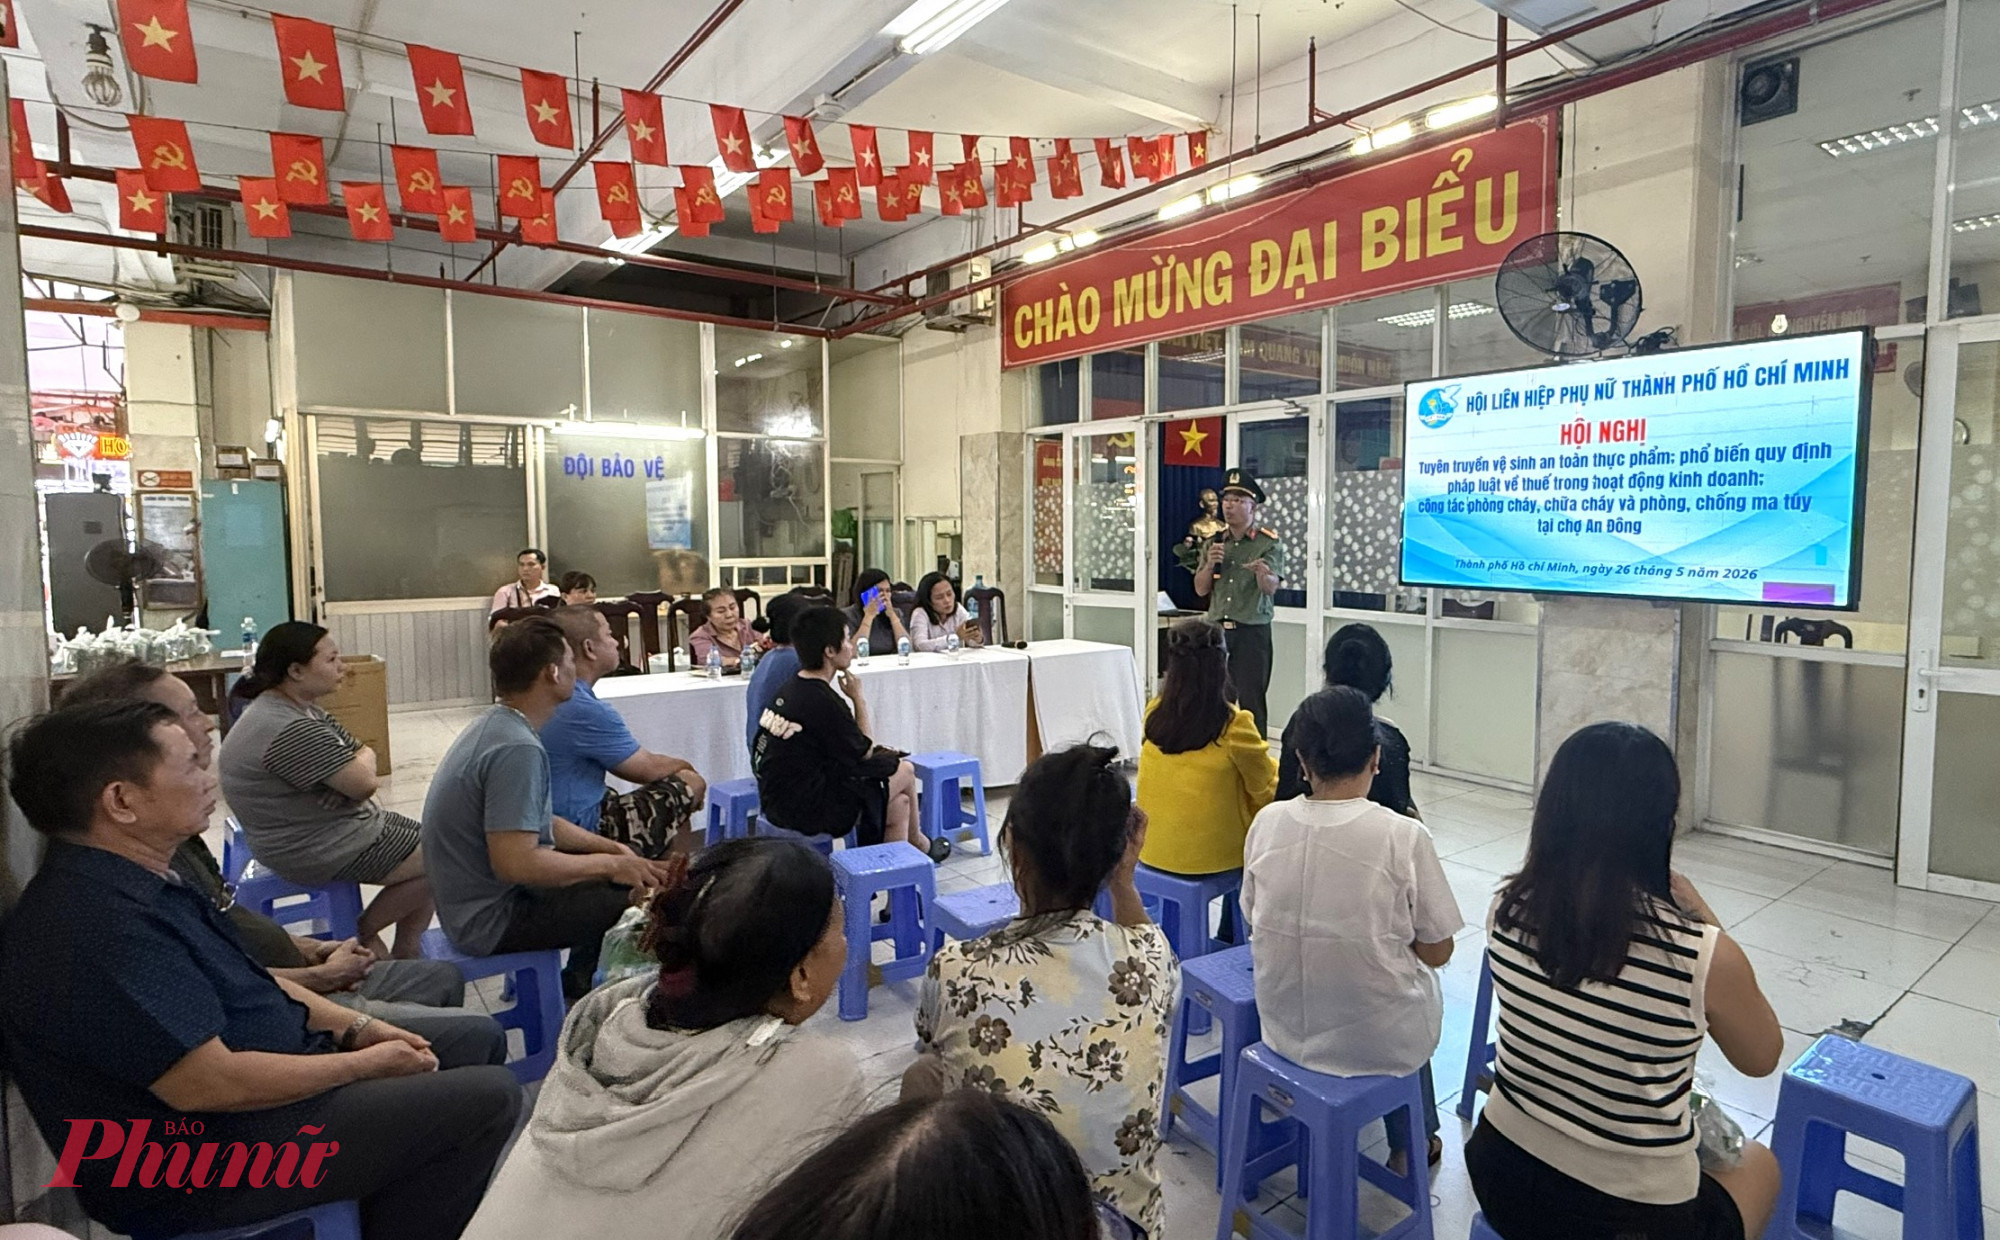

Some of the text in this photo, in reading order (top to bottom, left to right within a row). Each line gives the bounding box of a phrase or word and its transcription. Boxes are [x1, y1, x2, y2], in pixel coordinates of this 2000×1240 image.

[1014, 147, 1519, 349] CHÀO MỪNG ĐẠI BIỂU
[1259, 342, 1300, 364] QUANG
[1466, 358, 1849, 415] HỘI LIÊN HIỆP PHỤ NỮ THÀNH PHỐ HỒ CHÍ MINH
[1560, 417, 1646, 449] HỘI NGHỊ
[564, 452, 665, 481] ĐỘI BẢO VỆ
[1419, 442, 1832, 476] Tuyên truyền vệ sinh an toàn thực phẩm; phổ biến quy định
[1448, 469, 1764, 495] pháp luật về thuế trong hoạt động kinh doanh;
[1418, 492, 1813, 514] công tác phòng cháy, chữa cháy và phòng, chống ma túy
[1537, 517, 1642, 536] tại chợ An Đông
[1455, 559, 1758, 580] Thành phố Hồ chí Minh, ngày 26 tháng 5 năm 2026
